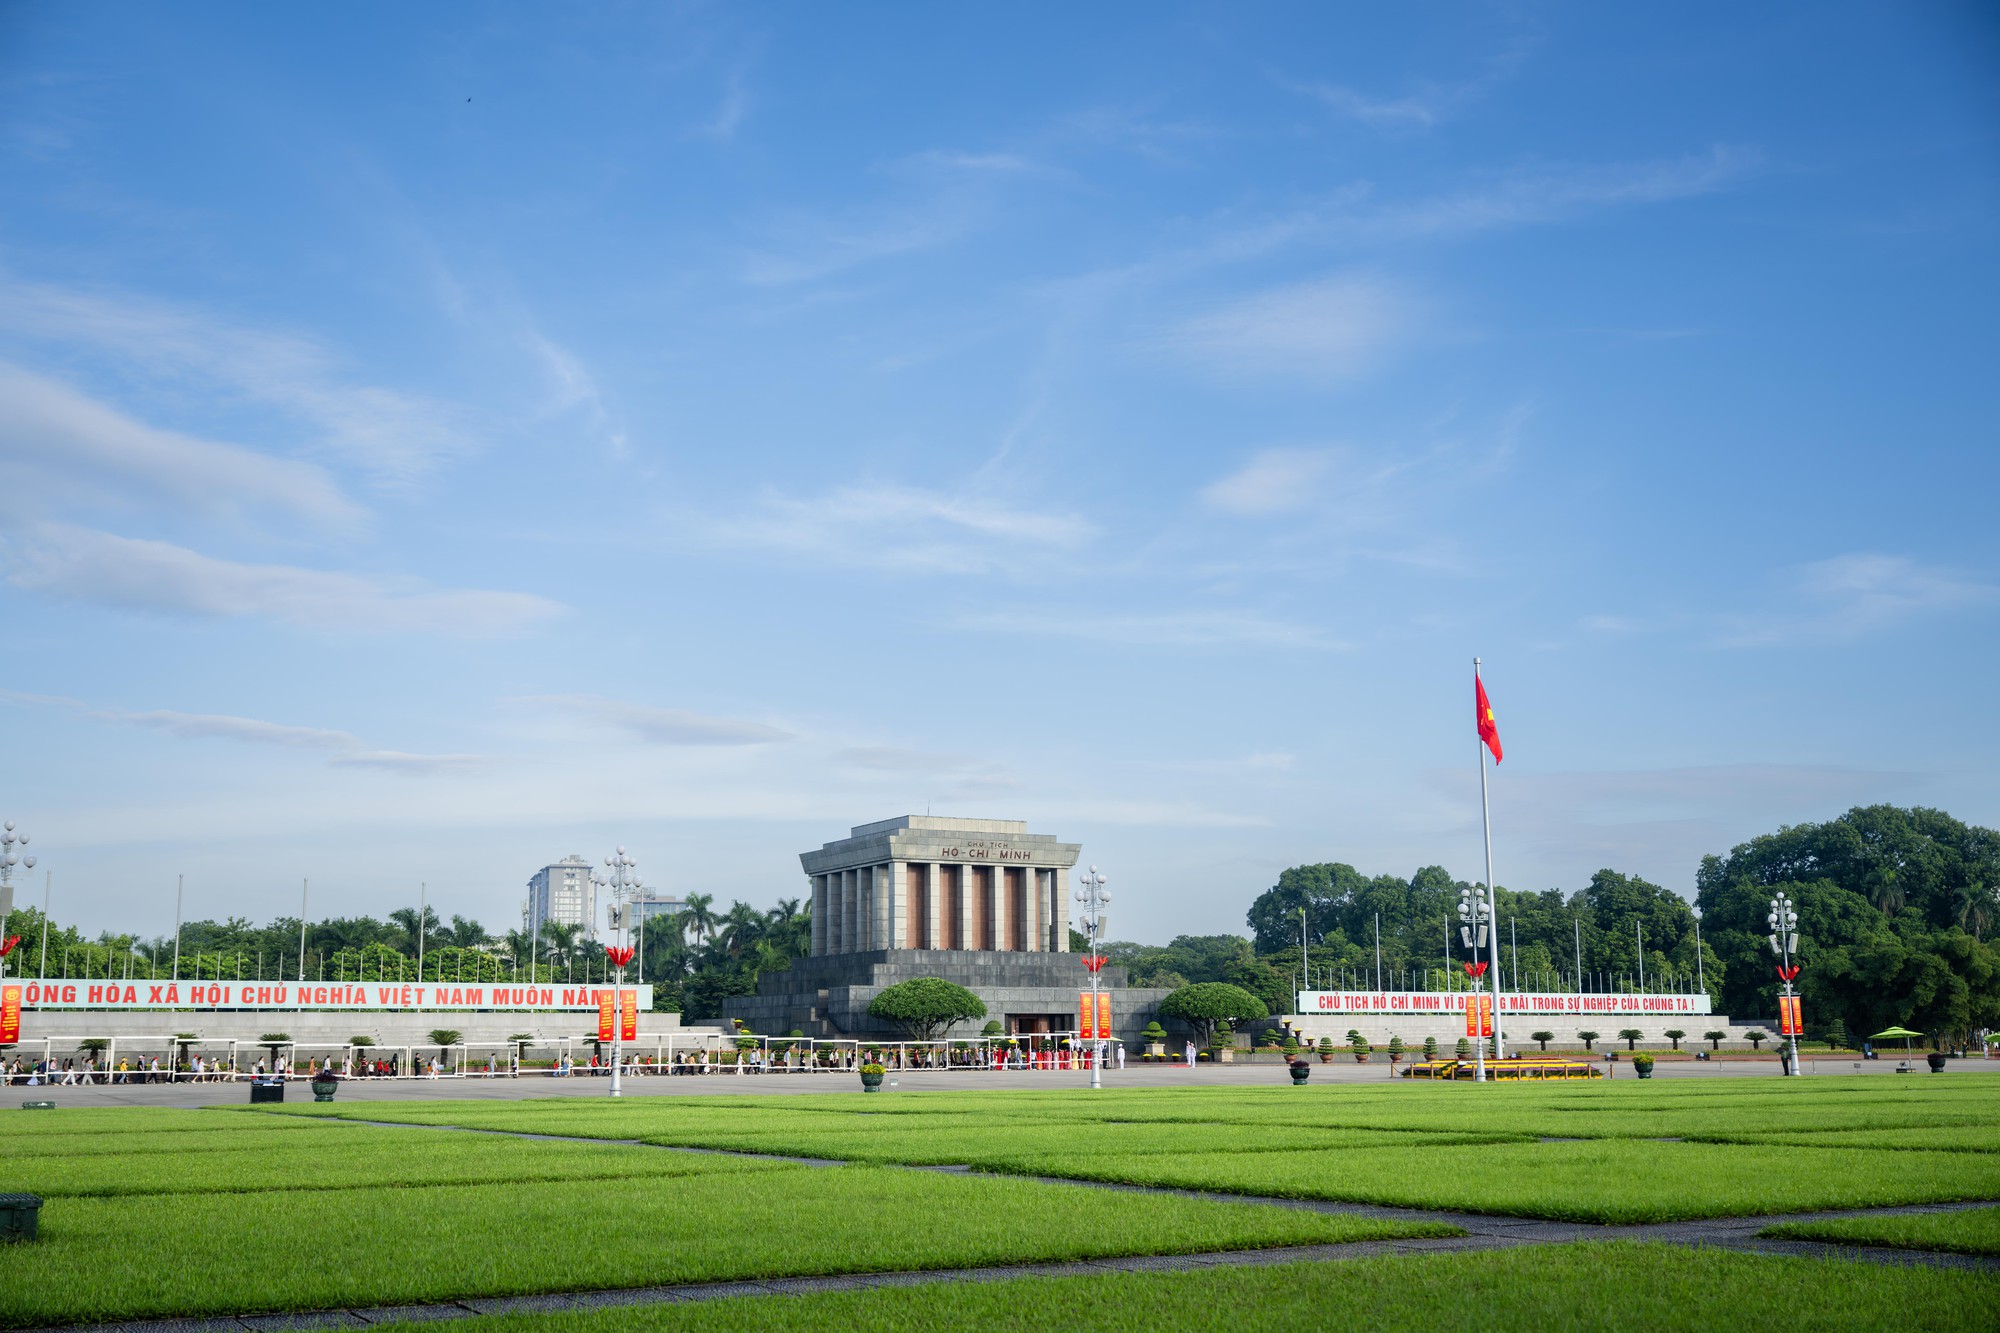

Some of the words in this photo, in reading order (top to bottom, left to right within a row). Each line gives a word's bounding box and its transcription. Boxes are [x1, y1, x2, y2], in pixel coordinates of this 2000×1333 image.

[26, 981, 77, 1006] ỘNG
[88, 981, 137, 1004] HÒA
[149, 981, 179, 1004] XÃ
[190, 981, 231, 1007] HỘI
[242, 981, 287, 1004] CHỦ
[298, 983, 367, 1004] NGHĨA
[379, 983, 425, 1008] VIỆT
[436, 988, 483, 1005] NAM
[493, 985, 554, 1006] MUÔN
[1319, 992, 1341, 1009] CHỦ
[1345, 995, 1369, 1011] TỊCH
[1373, 991, 1387, 1009] HỒ
[1391, 993, 1408, 1009] CHÍ
[1413, 996, 1440, 1009] MINH
[1444, 994, 1454, 1009] VĨ
[1510, 995, 1529, 1010] MÃI
[1532, 997, 1565, 1011] TRONG
[1568, 994, 1582, 1012] SỰ
[1584, 994, 1618, 1012] NGHIỆP
[1621, 994, 1640, 1011] CỦA
[1643, 996, 1674, 1011] CHÚNG
[1677, 998, 1688, 1010] TA
